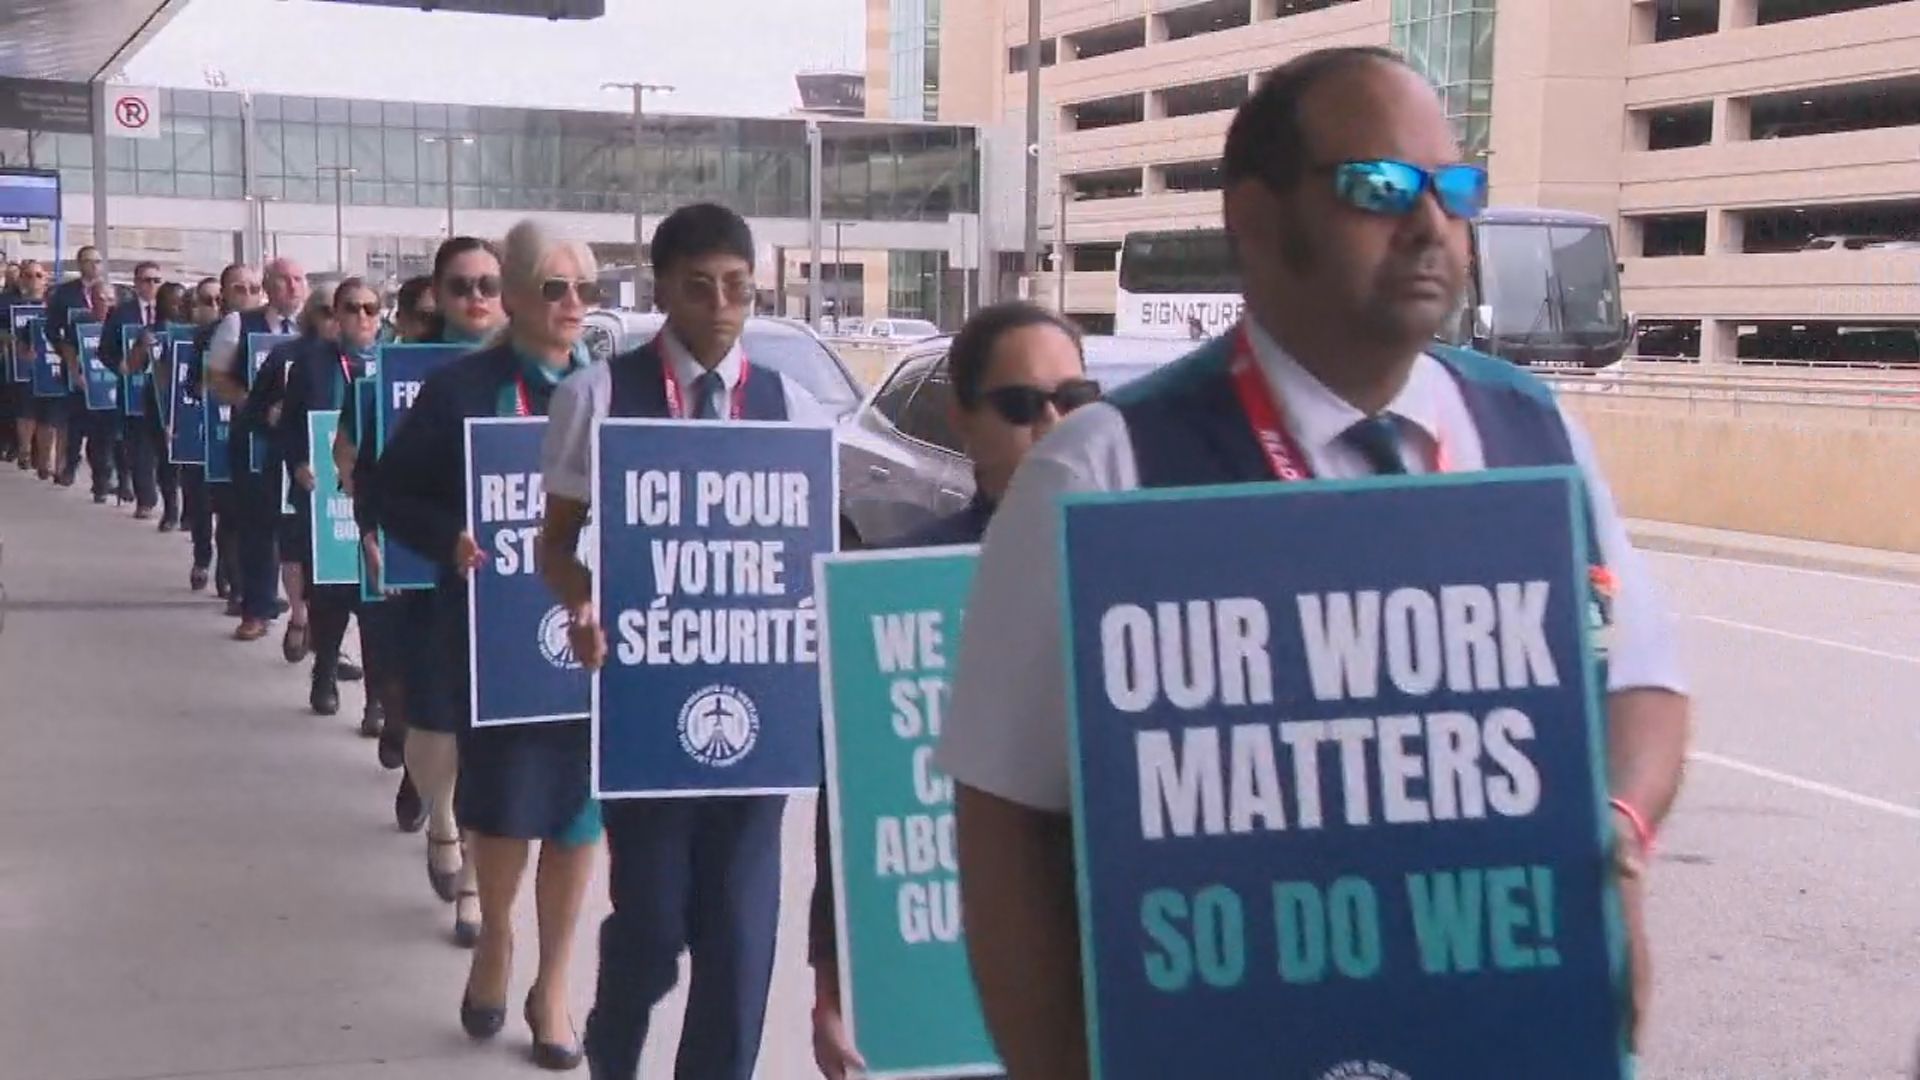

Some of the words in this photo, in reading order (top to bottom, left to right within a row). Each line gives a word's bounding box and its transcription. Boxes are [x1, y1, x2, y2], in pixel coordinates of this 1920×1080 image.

[480, 472, 548, 522] REA
[625, 470, 681, 527] ICI
[696, 471, 809, 527] POUR
[651, 540, 785, 596] VOTRE
[617, 596, 817, 665] SÉCURITÉ
[871, 610, 946, 672] WE
[1101, 597, 1273, 712] OUR
[1296, 581, 1560, 700] WORK
[1136, 707, 1541, 840] MATTERS
[875, 814, 958, 876] ABO
[1140, 886, 1246, 992] SO
[1272, 875, 1381, 984] DO
[1405, 866, 1560, 975] WE!
